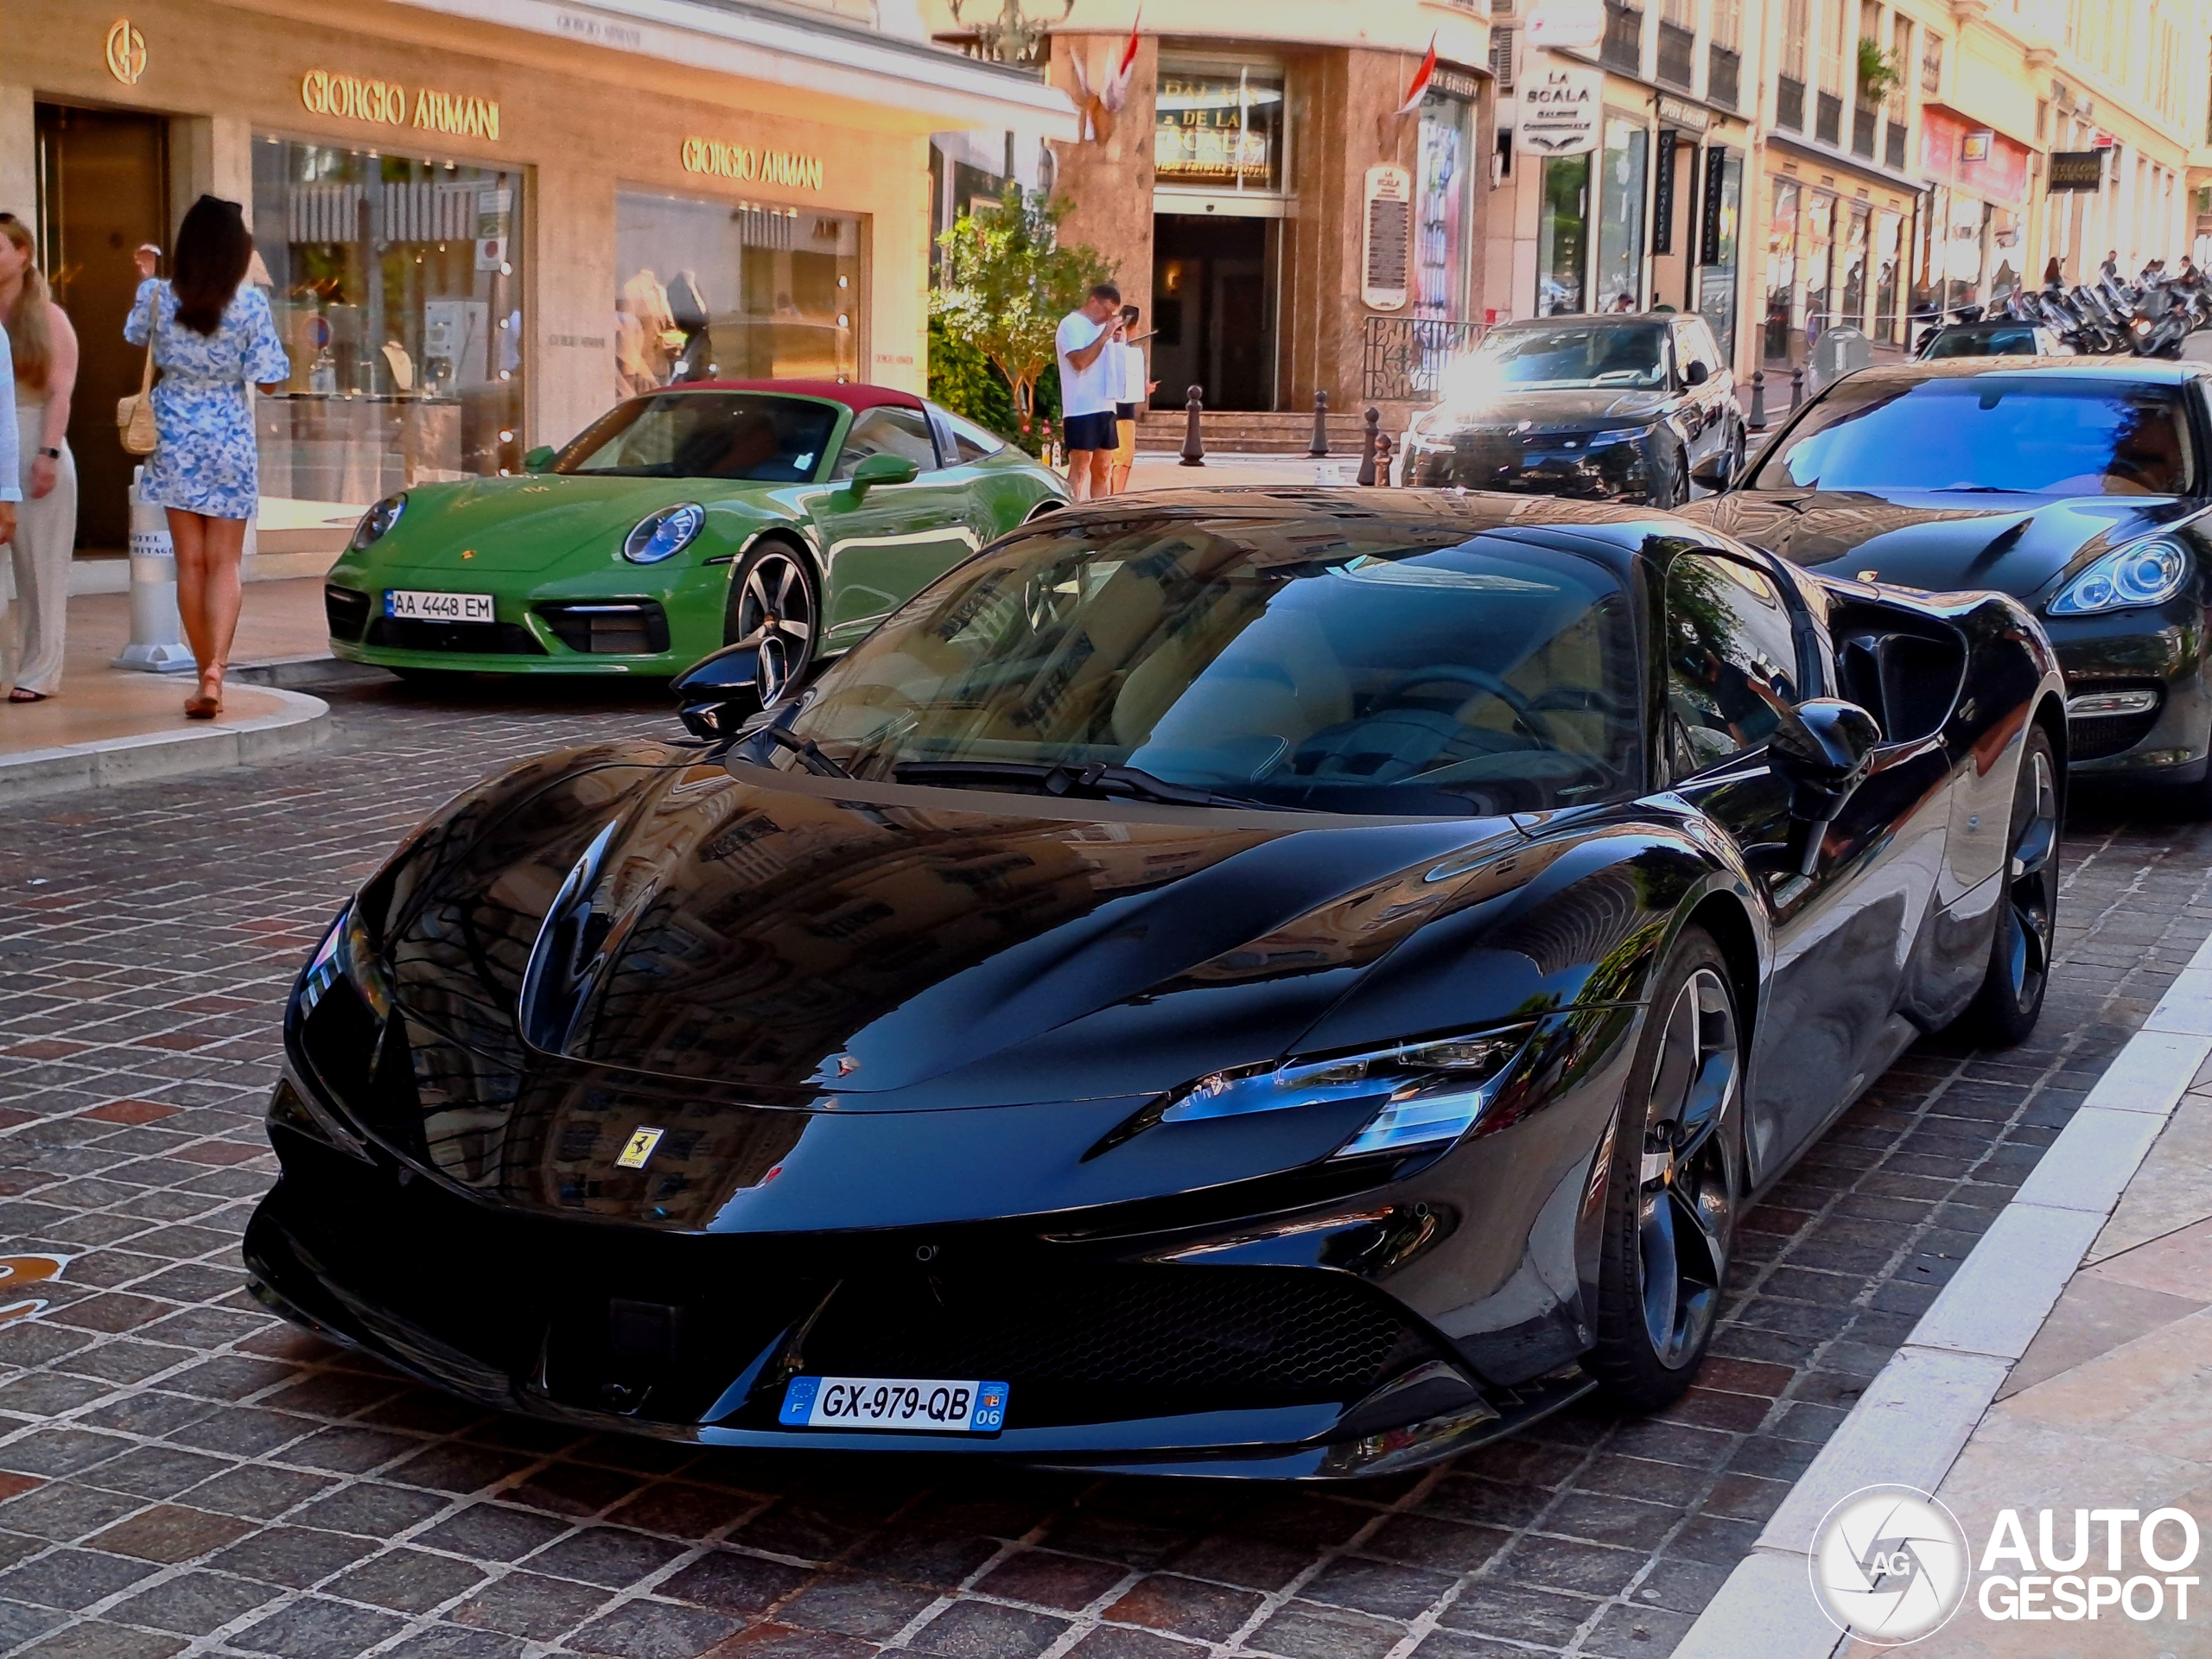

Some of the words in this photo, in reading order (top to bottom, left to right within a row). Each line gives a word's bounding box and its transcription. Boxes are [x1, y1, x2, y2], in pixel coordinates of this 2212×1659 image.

[1548, 73, 1568, 85] LA
[302, 70, 406, 125] GIORGIO
[412, 88, 499, 141] ARMANI
[1527, 90, 1589, 103] SCALA
[1183, 110, 1207, 126] DE
[1215, 111, 1240, 128] LA
[682, 139, 755, 181] GIORGIO
[760, 149, 823, 191] ARMANI
[395, 594, 416, 614] AA
[422, 596, 460, 616] 4448
[465, 598, 490, 618] EM
[791, 1402, 805, 1413] F
[822, 1384, 971, 1422] GX-979-QB
[976, 1409, 1001, 1426] 06
